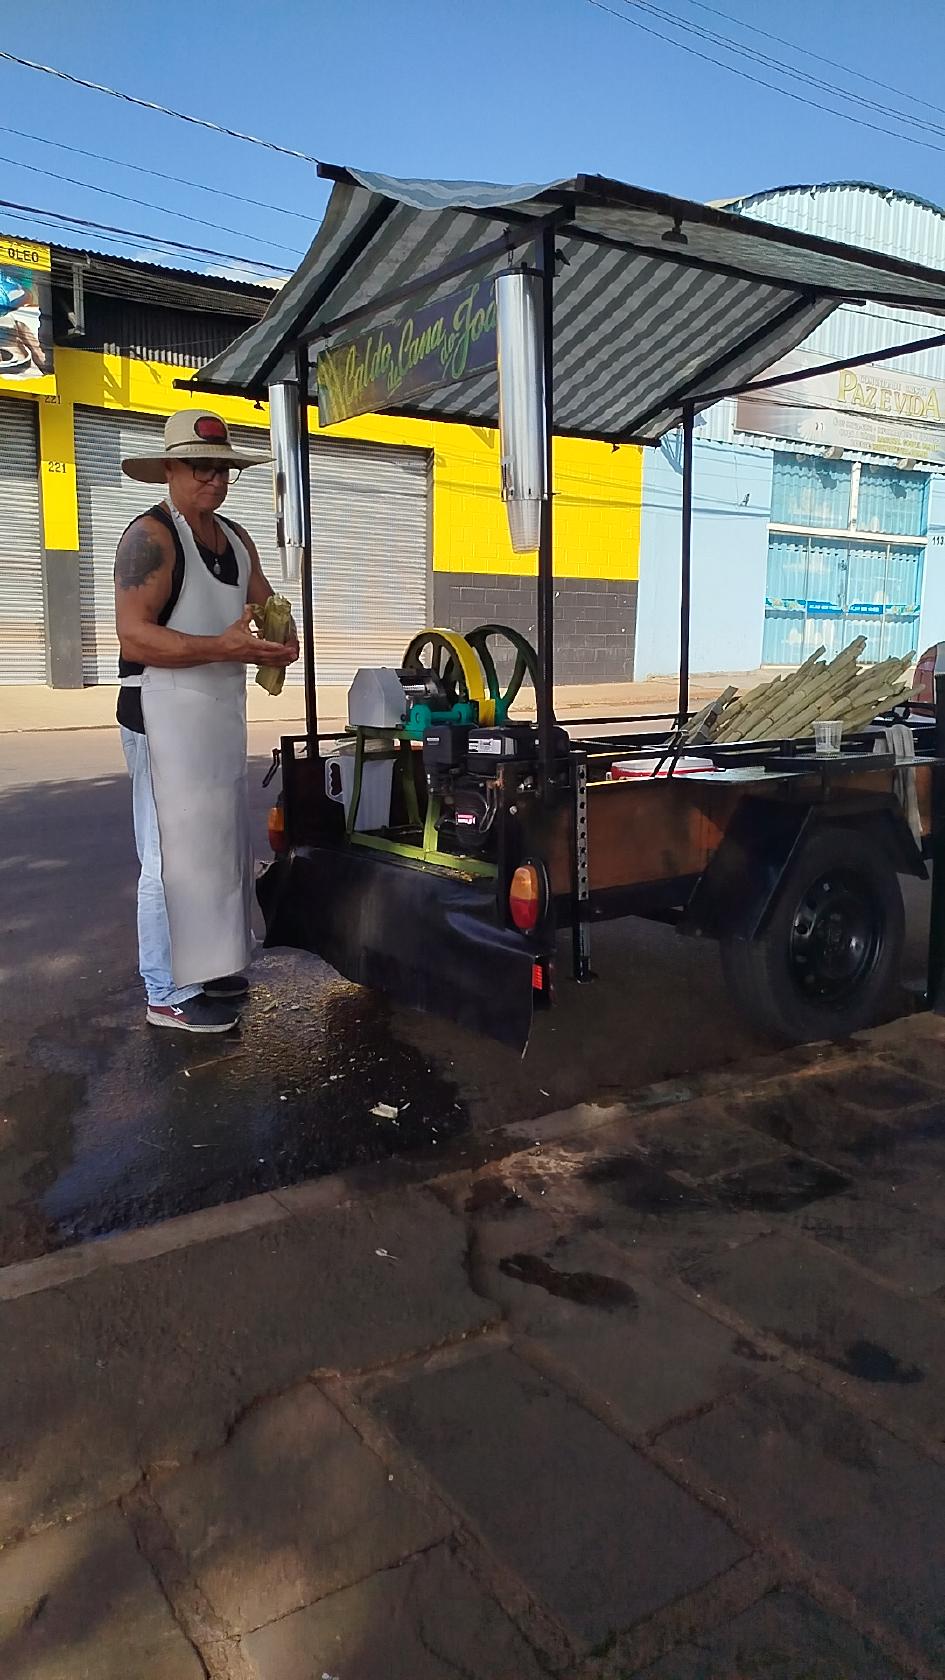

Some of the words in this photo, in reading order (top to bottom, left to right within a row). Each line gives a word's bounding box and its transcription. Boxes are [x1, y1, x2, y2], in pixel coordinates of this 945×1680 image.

[344, 330, 392, 404] Caldo
[387, 359, 402, 392] de
[398, 318, 444, 376] Cana
[440, 328, 460, 365] do
[44, 395, 61, 405] 221
[837, 370, 877, 410] PAZ
[879, 388, 893, 412] E
[894, 386, 941, 421] VIDA
[48, 461, 67, 473] 221
